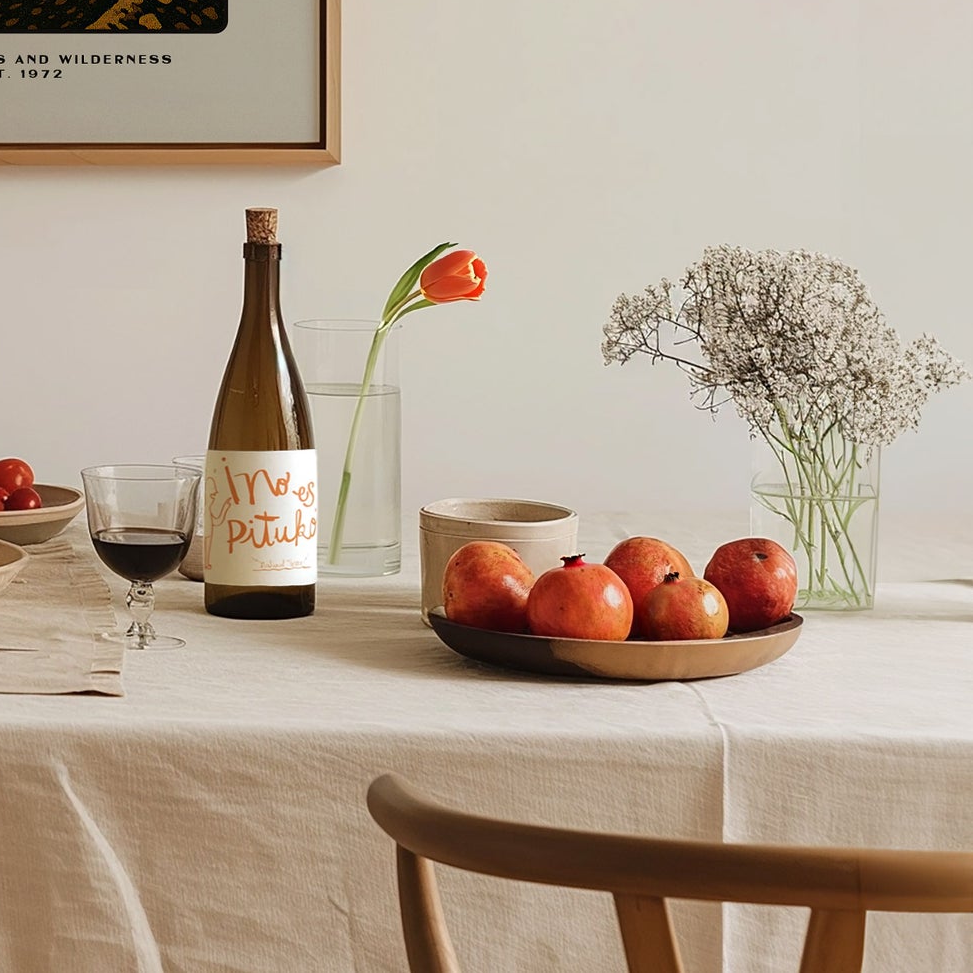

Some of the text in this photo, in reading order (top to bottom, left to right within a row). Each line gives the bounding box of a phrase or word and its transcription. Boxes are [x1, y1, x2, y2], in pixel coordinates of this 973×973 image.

[14, 54, 49, 65] AND
[58, 54, 173, 65] WILDERNESS
[20, 69, 63, 79] 1972
